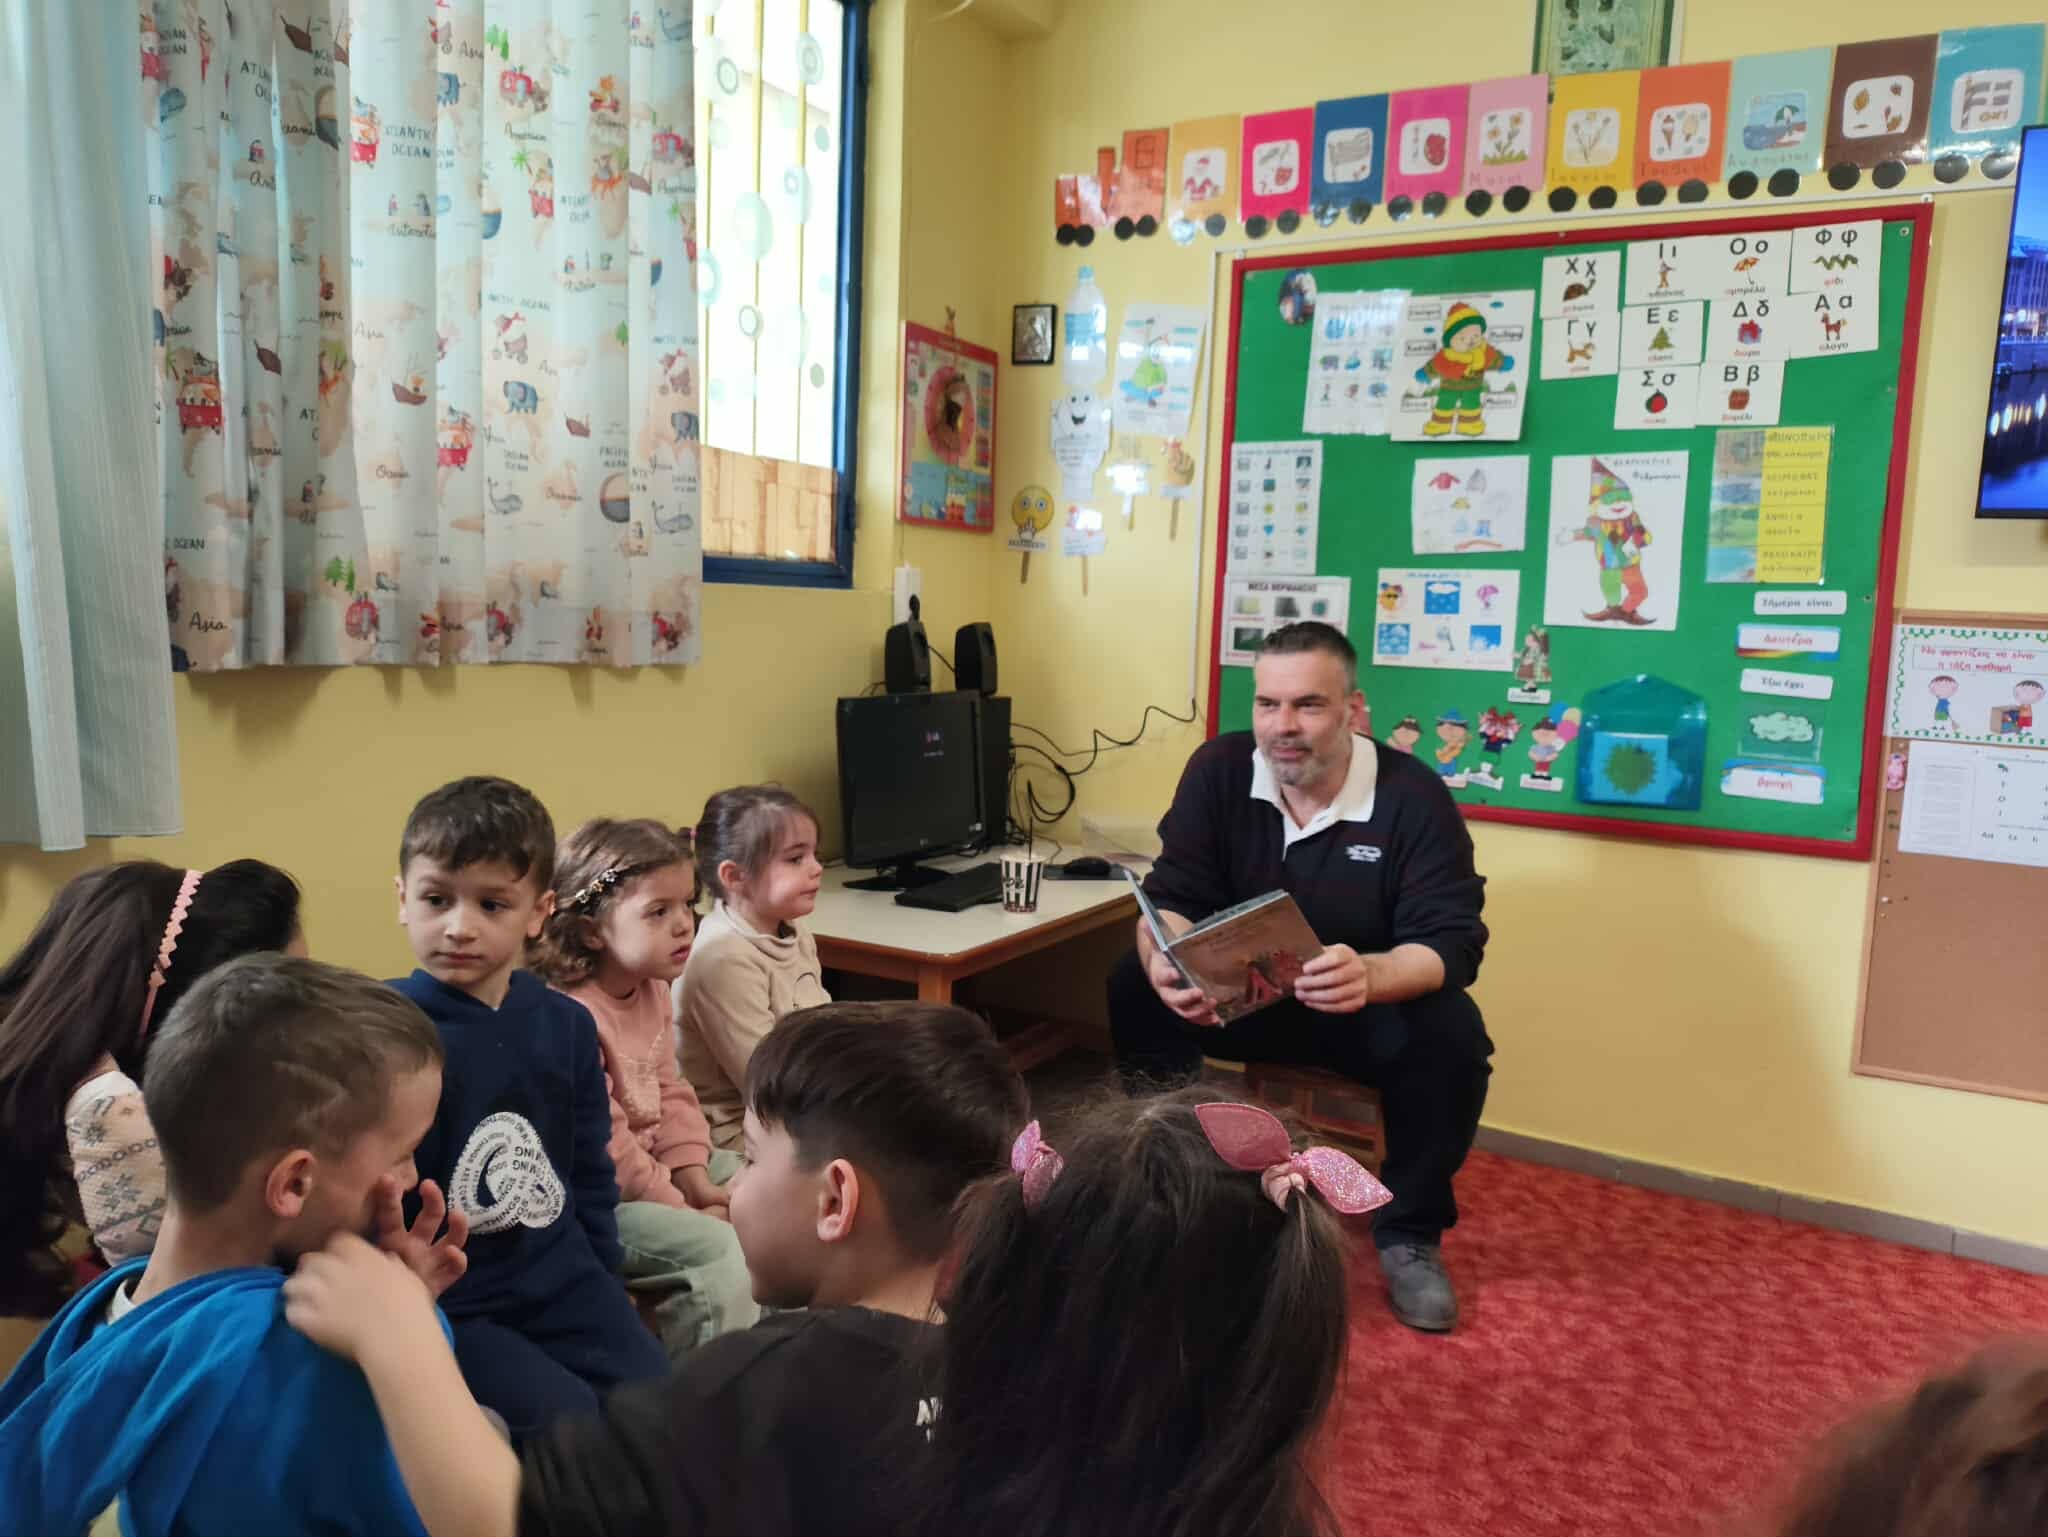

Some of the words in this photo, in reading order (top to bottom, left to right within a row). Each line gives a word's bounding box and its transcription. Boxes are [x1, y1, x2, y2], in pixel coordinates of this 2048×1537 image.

[1730, 238, 1747, 255] Ο
[1755, 240, 1769, 253] ο
[1815, 228, 1832, 245] Φ
[1841, 229, 1858, 248] φ
[1659, 243, 1664, 259] Ι
[1566, 257, 1578, 275] Χ
[1585, 259, 1597, 278] χ
[1732, 301, 1748, 317] Δ
[1756, 299, 1769, 317] δ
[1814, 294, 1831, 312] Α
[1839, 295, 1853, 309] α
[1647, 307, 1660, 325] Ε
[1668, 309, 1679, 323] ε
[1567, 320, 1579, 336] Γ
[1586, 321, 1597, 338] γ
[1641, 370, 1655, 387] Σ
[1662, 373, 1677, 386] σ
[1724, 365, 1738, 382] Β
[1746, 364, 1760, 387] β
